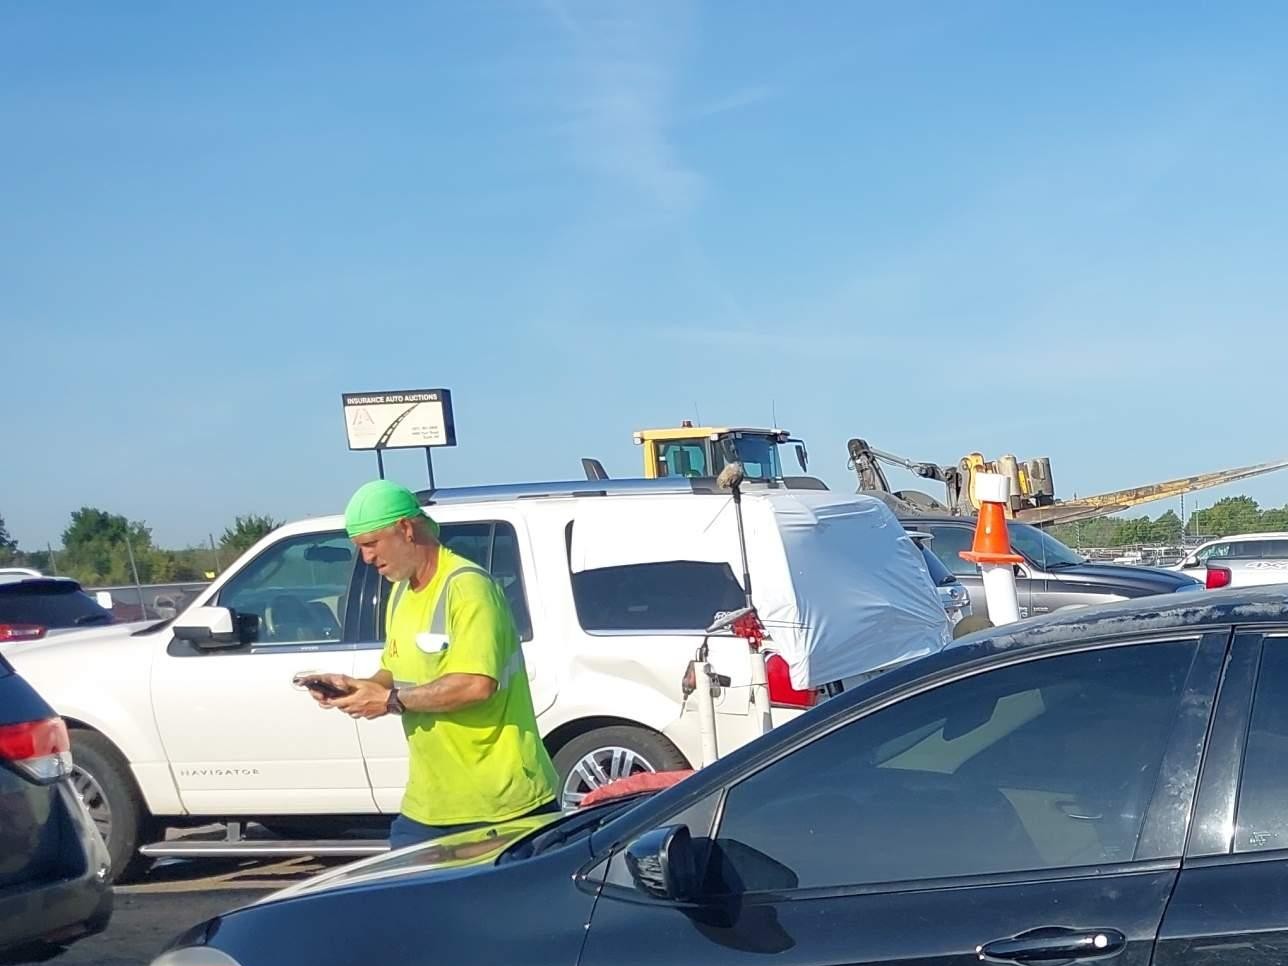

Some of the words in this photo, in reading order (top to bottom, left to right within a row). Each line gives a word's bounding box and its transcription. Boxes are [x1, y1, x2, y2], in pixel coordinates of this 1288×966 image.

[347, 396, 384, 405] INSURANCE
[385, 395, 403, 403] AUTO
[404, 393, 438, 402] AUCTIONS
[180, 768, 261, 776] NAVIGATOR
